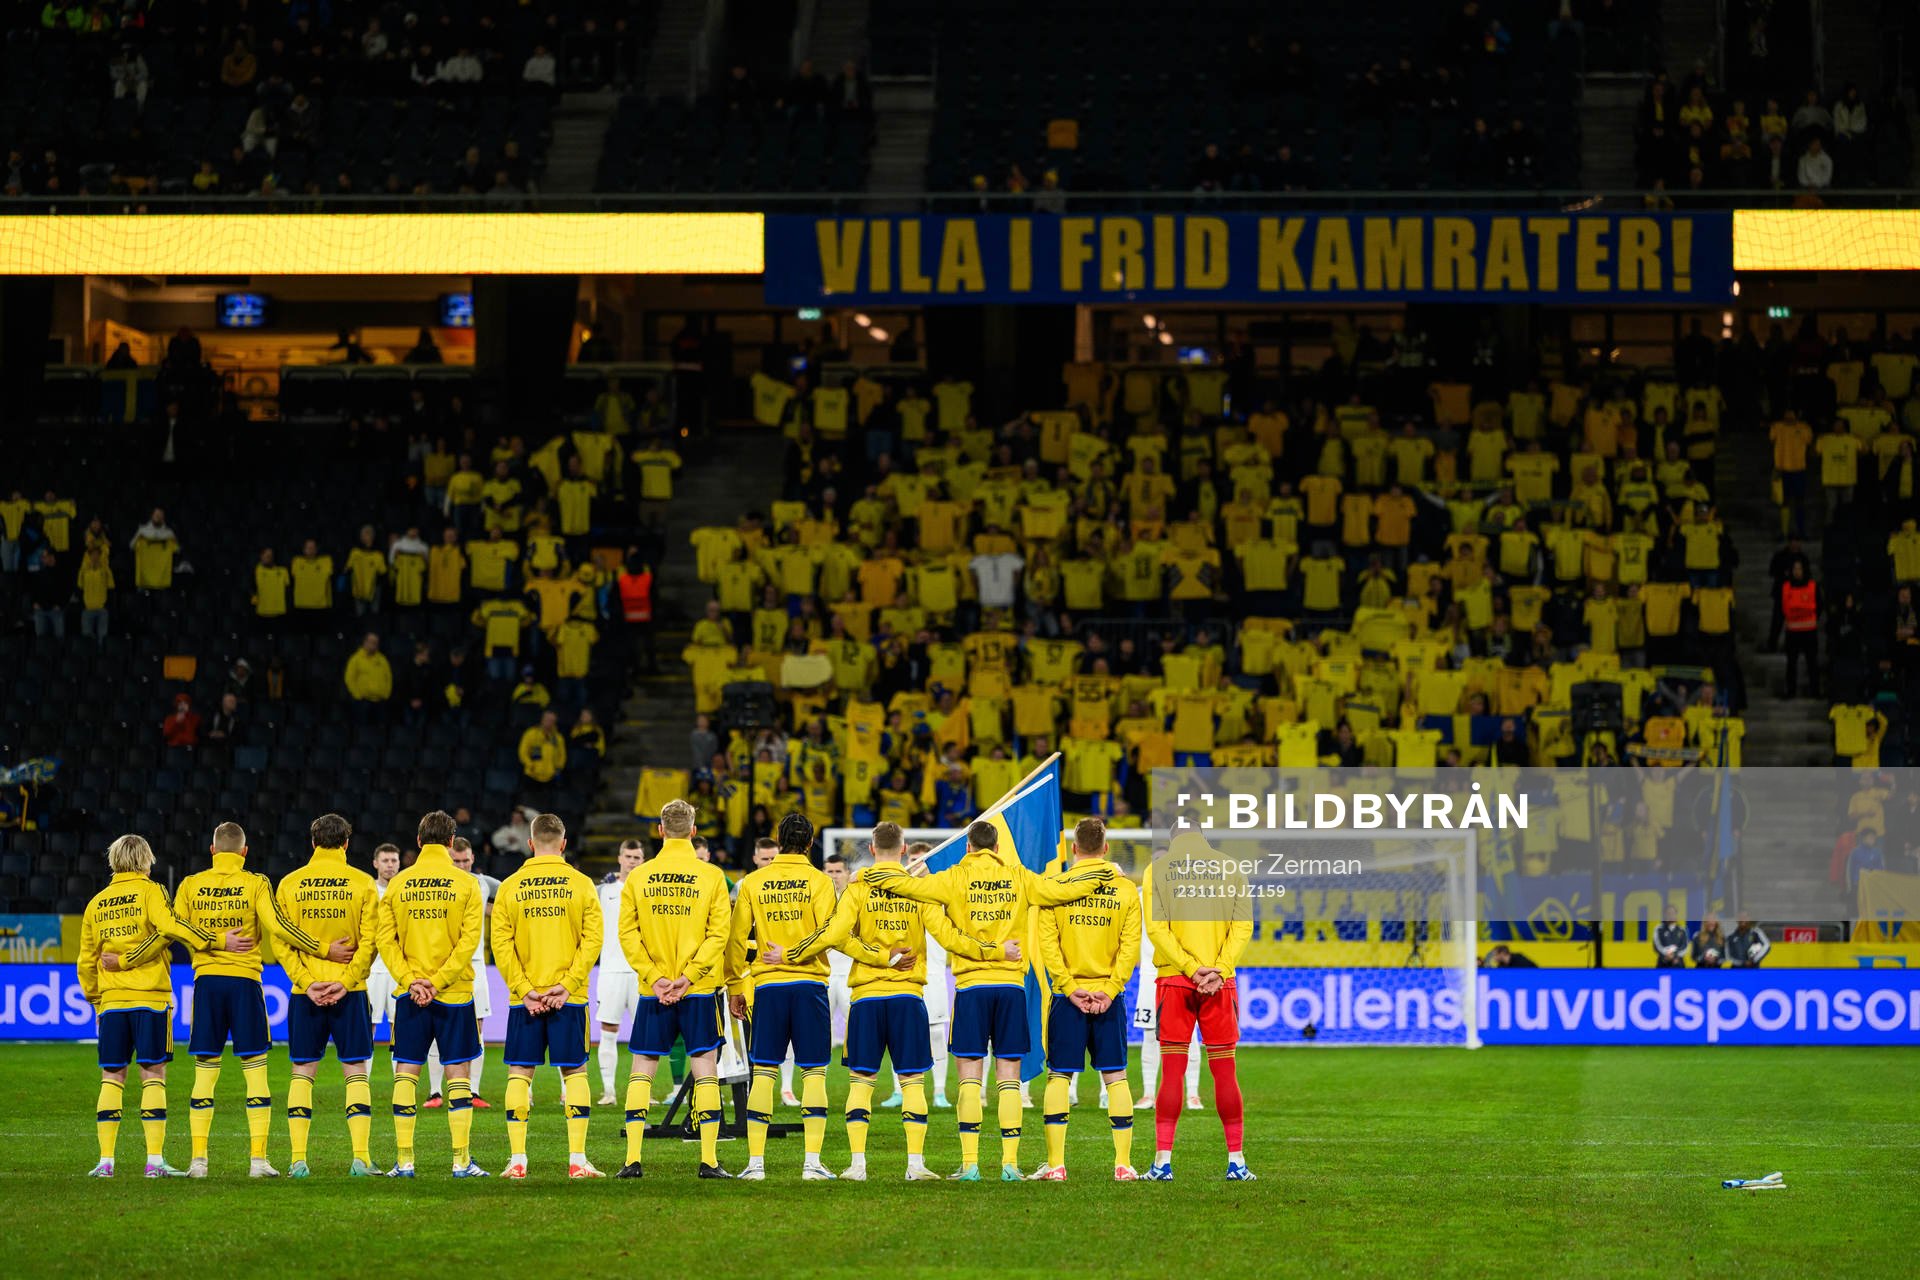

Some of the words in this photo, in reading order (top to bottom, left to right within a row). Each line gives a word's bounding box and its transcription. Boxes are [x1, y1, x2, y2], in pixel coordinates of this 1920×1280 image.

[815, 218, 986, 293] VILA
[1009, 218, 1032, 292] I
[1060, 215, 1229, 292] FRID
[1257, 217, 1693, 292] KAMRATER!
[299, 878, 350, 888] SVERIGE
[404, 878, 454, 889] SVERIGE
[519, 876, 570, 889] SVERIGE
[647, 873, 698, 884] SVERIGE
[762, 880, 808, 890] SVERIGE
[197, 886, 245, 897] SVERIGE
[295, 889, 353, 902] LUNDSTRÖM
[400, 889, 456, 902] LUNDSTRÖM
[515, 886, 573, 902] LUNDSTRÖM
[643, 886, 700, 898] LUNDSTRÖM
[967, 891, 1017, 904] UNDSTRÖM
[97, 893, 138, 909] SVERIGE
[302, 908, 346, 919] PERSSON
[408, 908, 448, 919] PERSSON
[524, 906, 566, 918] PERSSON
[652, 904, 691, 916] PERSSON
[970, 910, 1012, 921] PERSSON
[199, 917, 243, 928] PERSSON
[1069, 915, 1112, 926] PERSSON
[100, 924, 138, 939] PERSSON
[1134, 1008, 1151, 1023] 13
